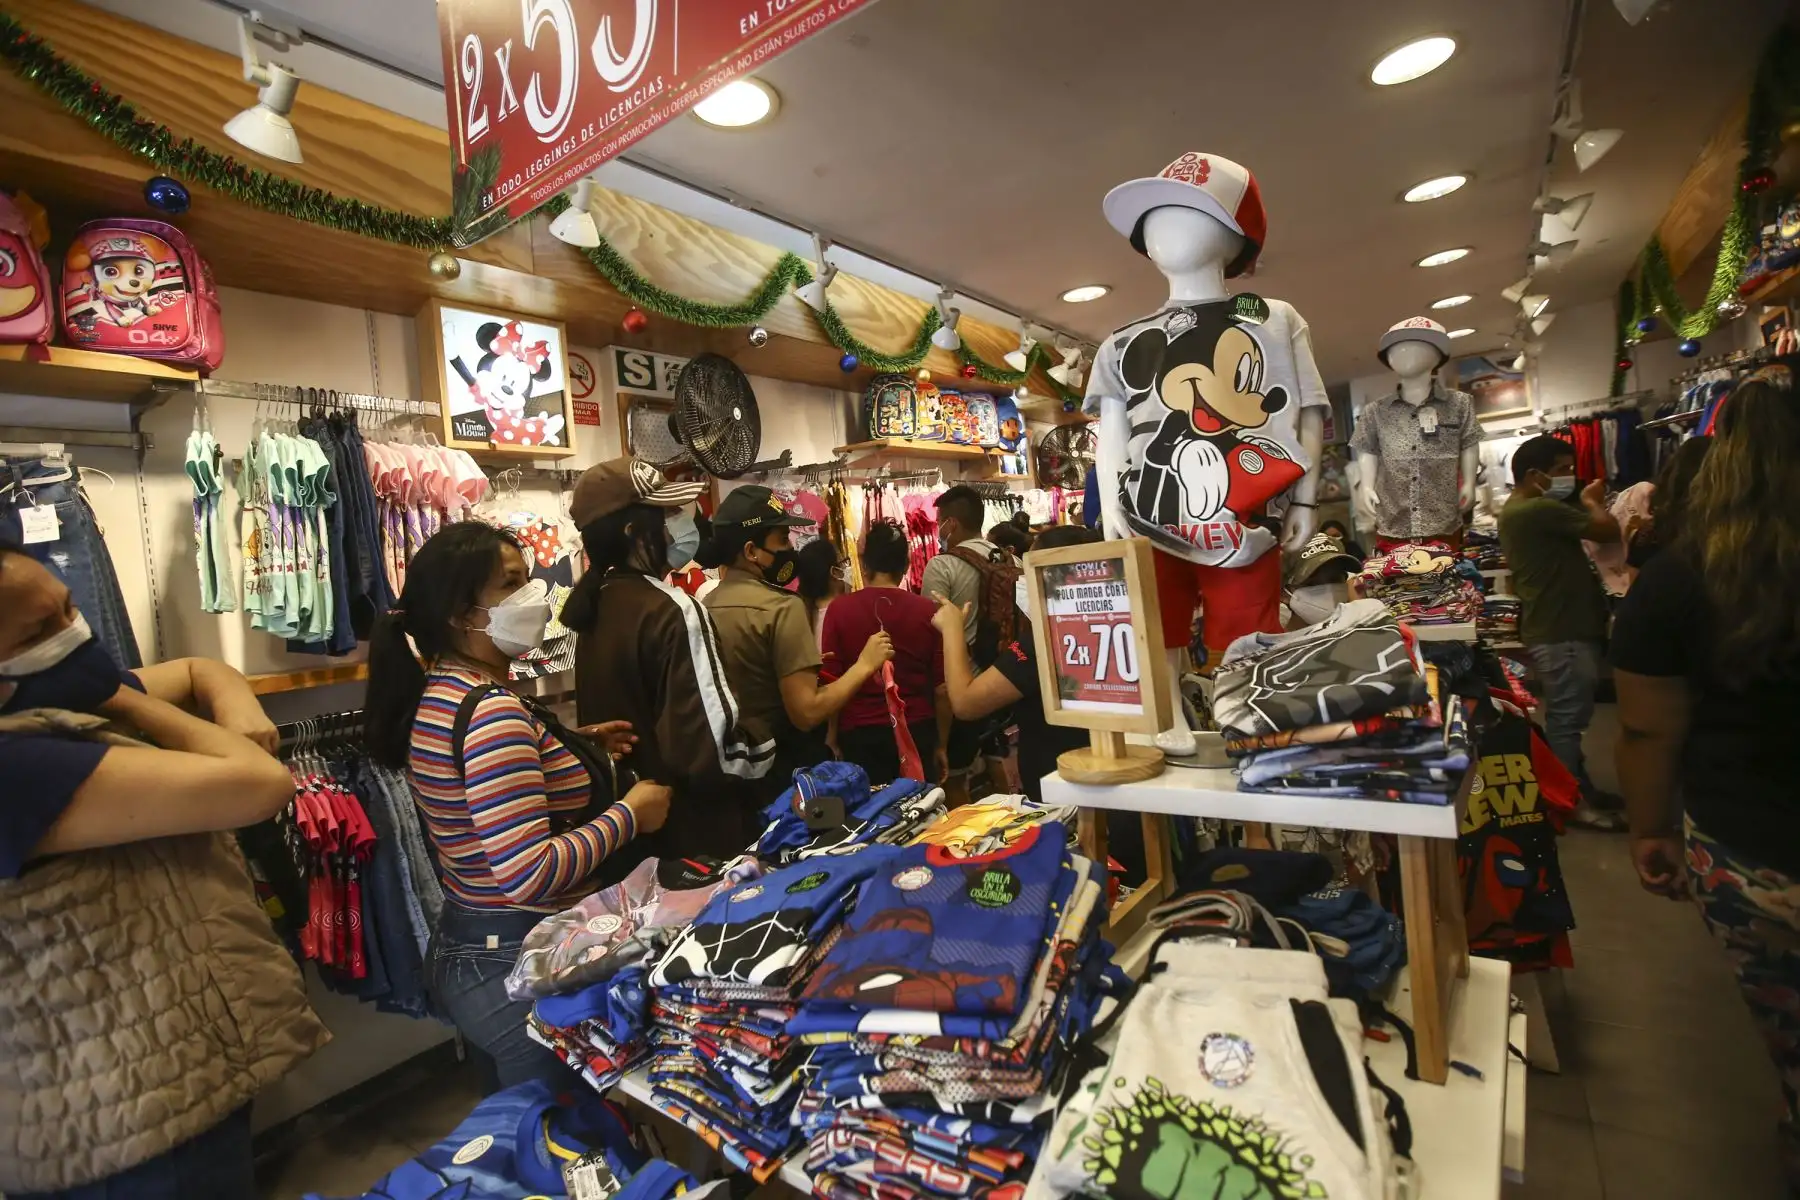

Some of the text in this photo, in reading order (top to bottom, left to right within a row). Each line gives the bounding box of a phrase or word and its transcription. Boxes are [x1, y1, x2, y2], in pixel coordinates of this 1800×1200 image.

[739, 0, 796, 34] EN TO
[462, 33, 489, 144] 2
[552, 176, 564, 190] LOS
[564, 153, 602, 183] PRODUCTOS
[602, 140, 618, 157] CON
[618, 111, 662, 147] PROMOCIÓN
[663, 107, 670, 118] U
[671, 87, 699, 113] OFERTA
[700, 64, 736, 95] ESPECIAL
[737, 54, 752, 71] NO
[753, 35, 782, 61] ESTÁN
[784, 9, 826, 43] SUJETOS
[827, 3, 837, 17] A
[483, 75, 663, 208] EN TODO LEGGINGS DE LICENCIAS
[1236, 297, 1260, 310] BRILLA
[128, 329, 168, 345] 04
[573, 401, 598, 410] HIBIDO
[742, 517, 762, 527] PERU
[1301, 544, 1339, 558] adidas
[1075, 561, 1107, 571] COMIC
[1076, 586, 1104, 599] MANGA
[1075, 600, 1114, 612] LICENCIAS
[1090, 622, 1140, 682] 70
[983, 871, 1011, 885] BRILLA
